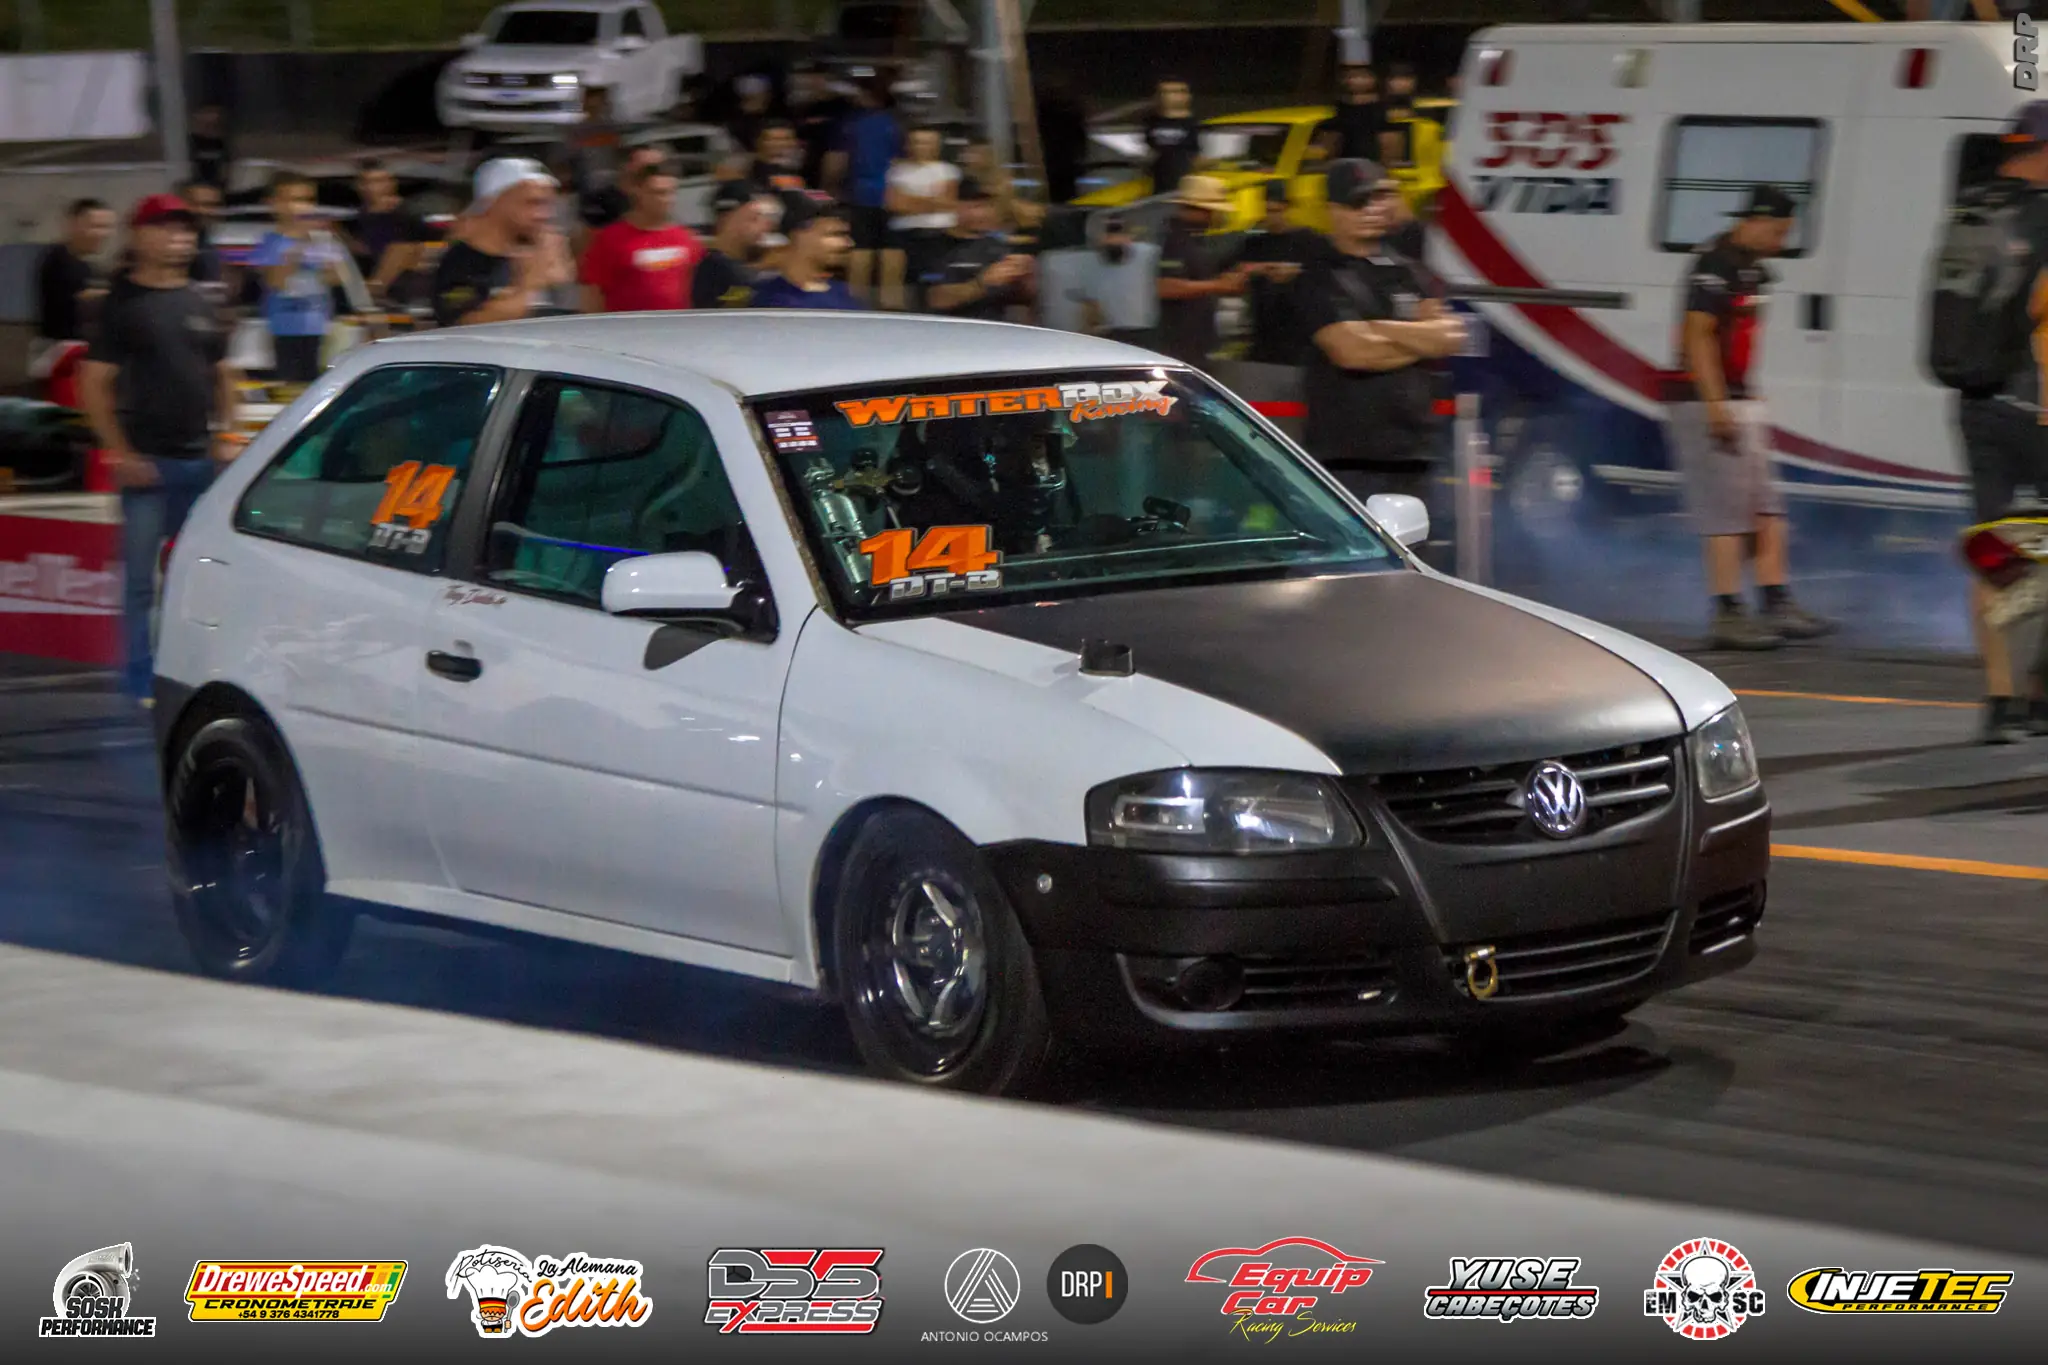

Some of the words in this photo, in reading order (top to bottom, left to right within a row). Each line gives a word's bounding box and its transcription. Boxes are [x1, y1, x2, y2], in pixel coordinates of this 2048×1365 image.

[1070, 397, 1176, 423] Racing
[370, 460, 456, 528] 14
[860, 525, 1002, 586] 14
